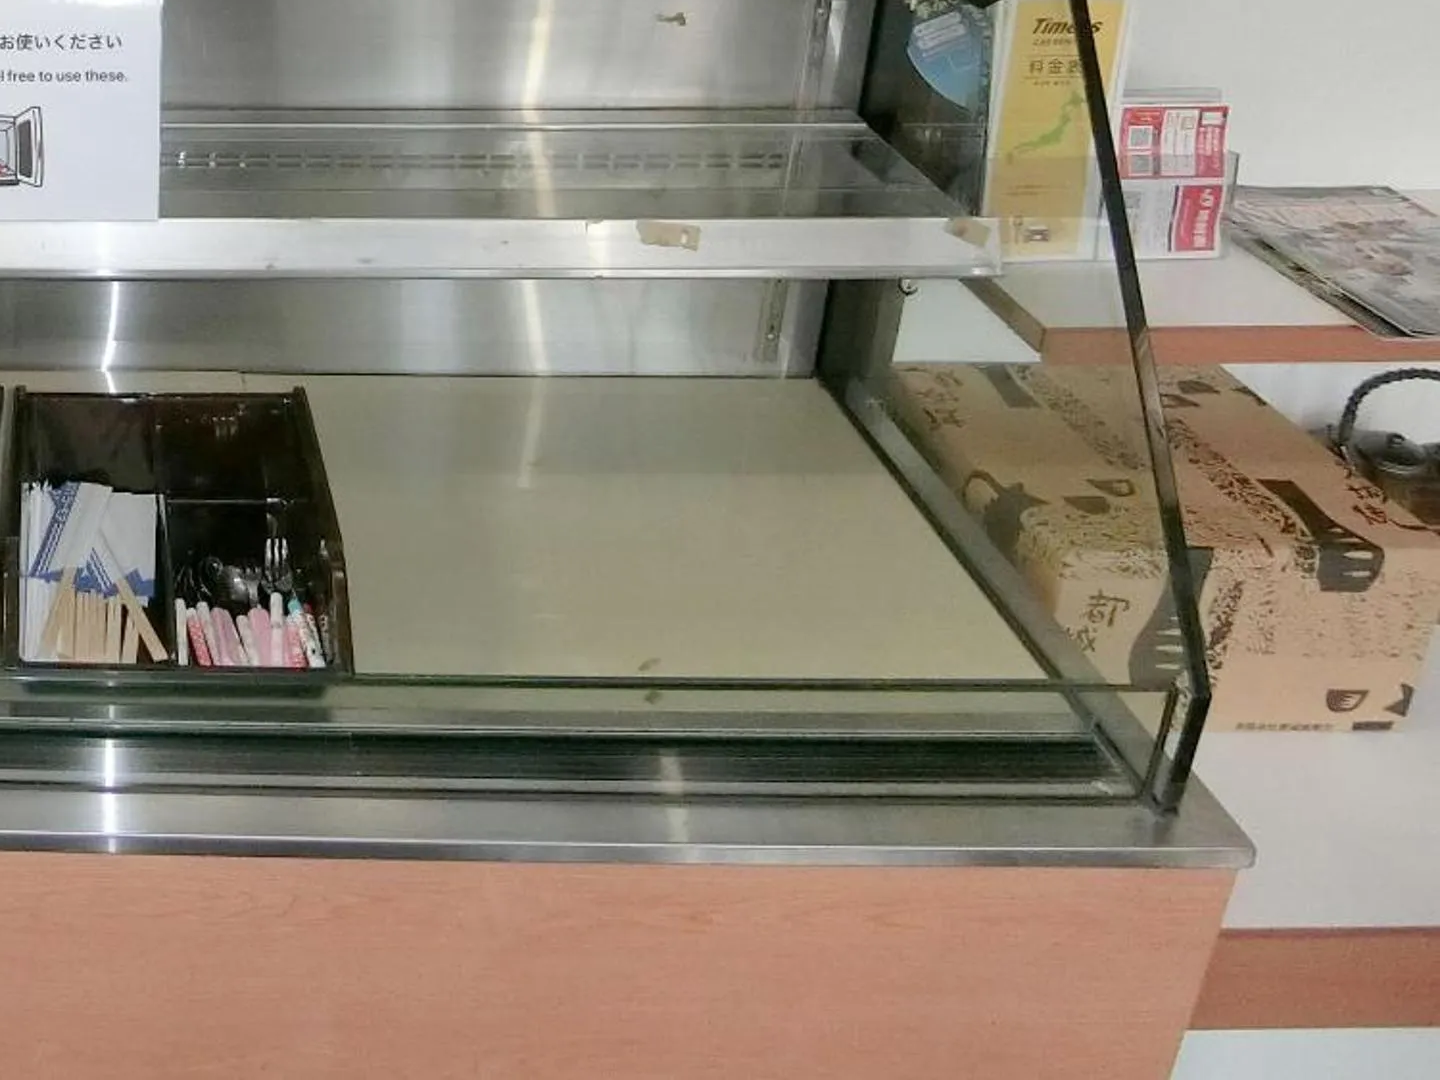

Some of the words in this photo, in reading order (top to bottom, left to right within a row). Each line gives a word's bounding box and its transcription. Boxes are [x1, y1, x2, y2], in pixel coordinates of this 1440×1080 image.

[8, 69, 35, 83] free
[39, 70, 53, 83] to
[56, 72, 82, 83] use
[85, 69, 128, 83] these.
